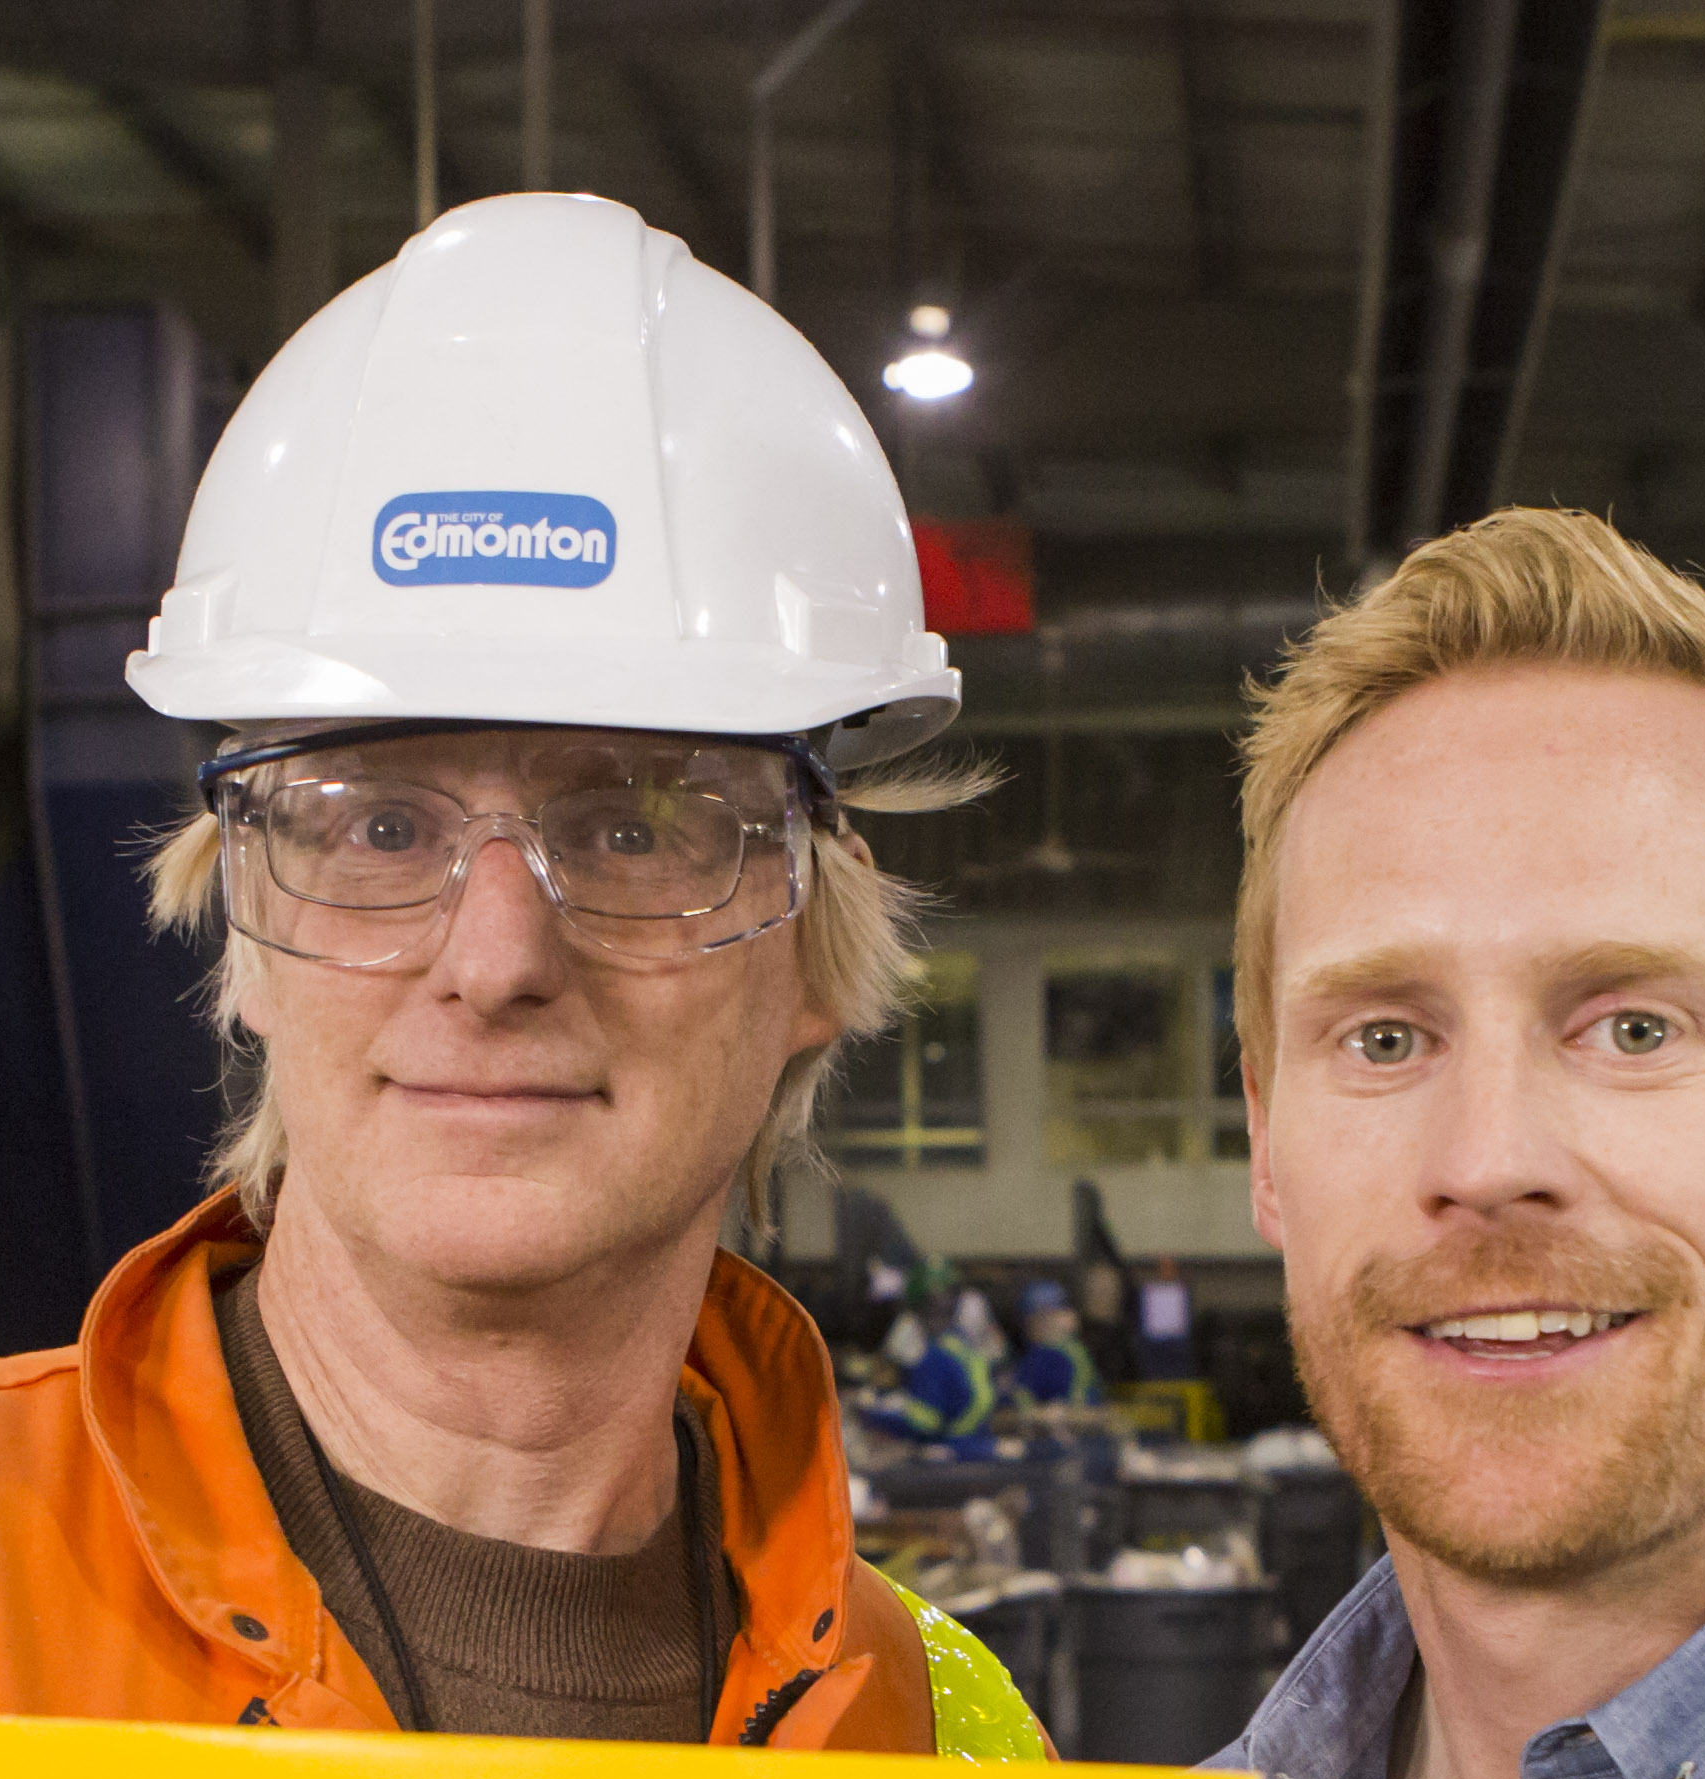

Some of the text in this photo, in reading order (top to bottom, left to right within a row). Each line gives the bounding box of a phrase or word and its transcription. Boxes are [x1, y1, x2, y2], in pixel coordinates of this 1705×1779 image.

[437, 512, 504, 523] THE CITY OF
[380, 511, 608, 571] Edmonton
